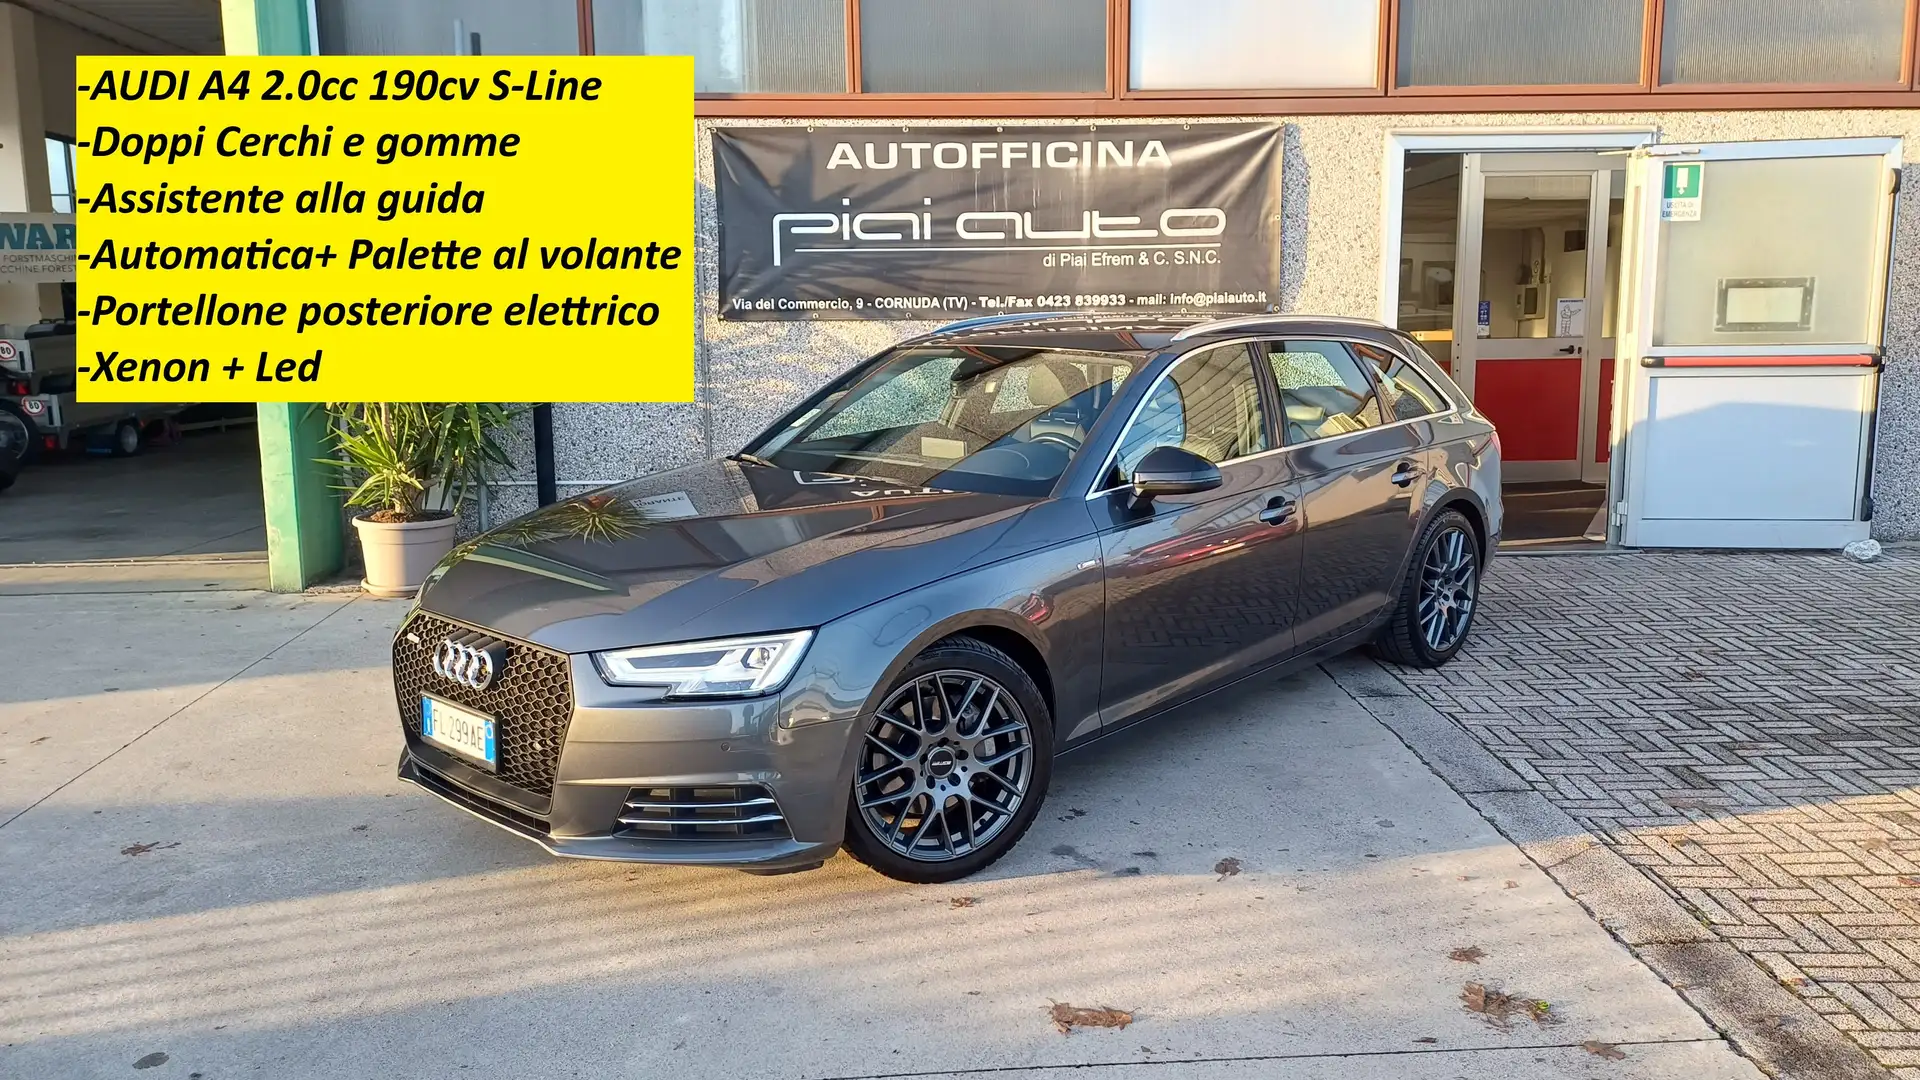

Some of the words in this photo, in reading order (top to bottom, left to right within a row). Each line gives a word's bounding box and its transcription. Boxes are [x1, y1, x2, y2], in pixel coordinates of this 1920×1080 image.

[826, 140, 1173, 170] AUTOFFICINA
[955, 207, 1227, 241] auto
[1043, 252, 1056, 267] di
[1060, 252, 1088, 267] Piai
[1091, 251, 1135, 267] Efrem
[1138, 251, 1150, 266] &
[1153, 250, 1170, 265] C.
[1174, 249, 1222, 265] S.N.C.
[732, 298, 752, 310] Via
[755, 298, 775, 310] del
[778, 297, 853, 311] Commercio,
[856, 297, 864, 309] 9
[875, 296, 941, 309] CORNUDA
[942, 296, 968, 311] (TV)
[978, 295, 1034, 308] Tel./Fax
[1037, 295, 1072, 307] 0423
[1074, 293, 1126, 306] 839933
[1136, 293, 1167, 306] mail:
[0, 346, 12, 355] 80
